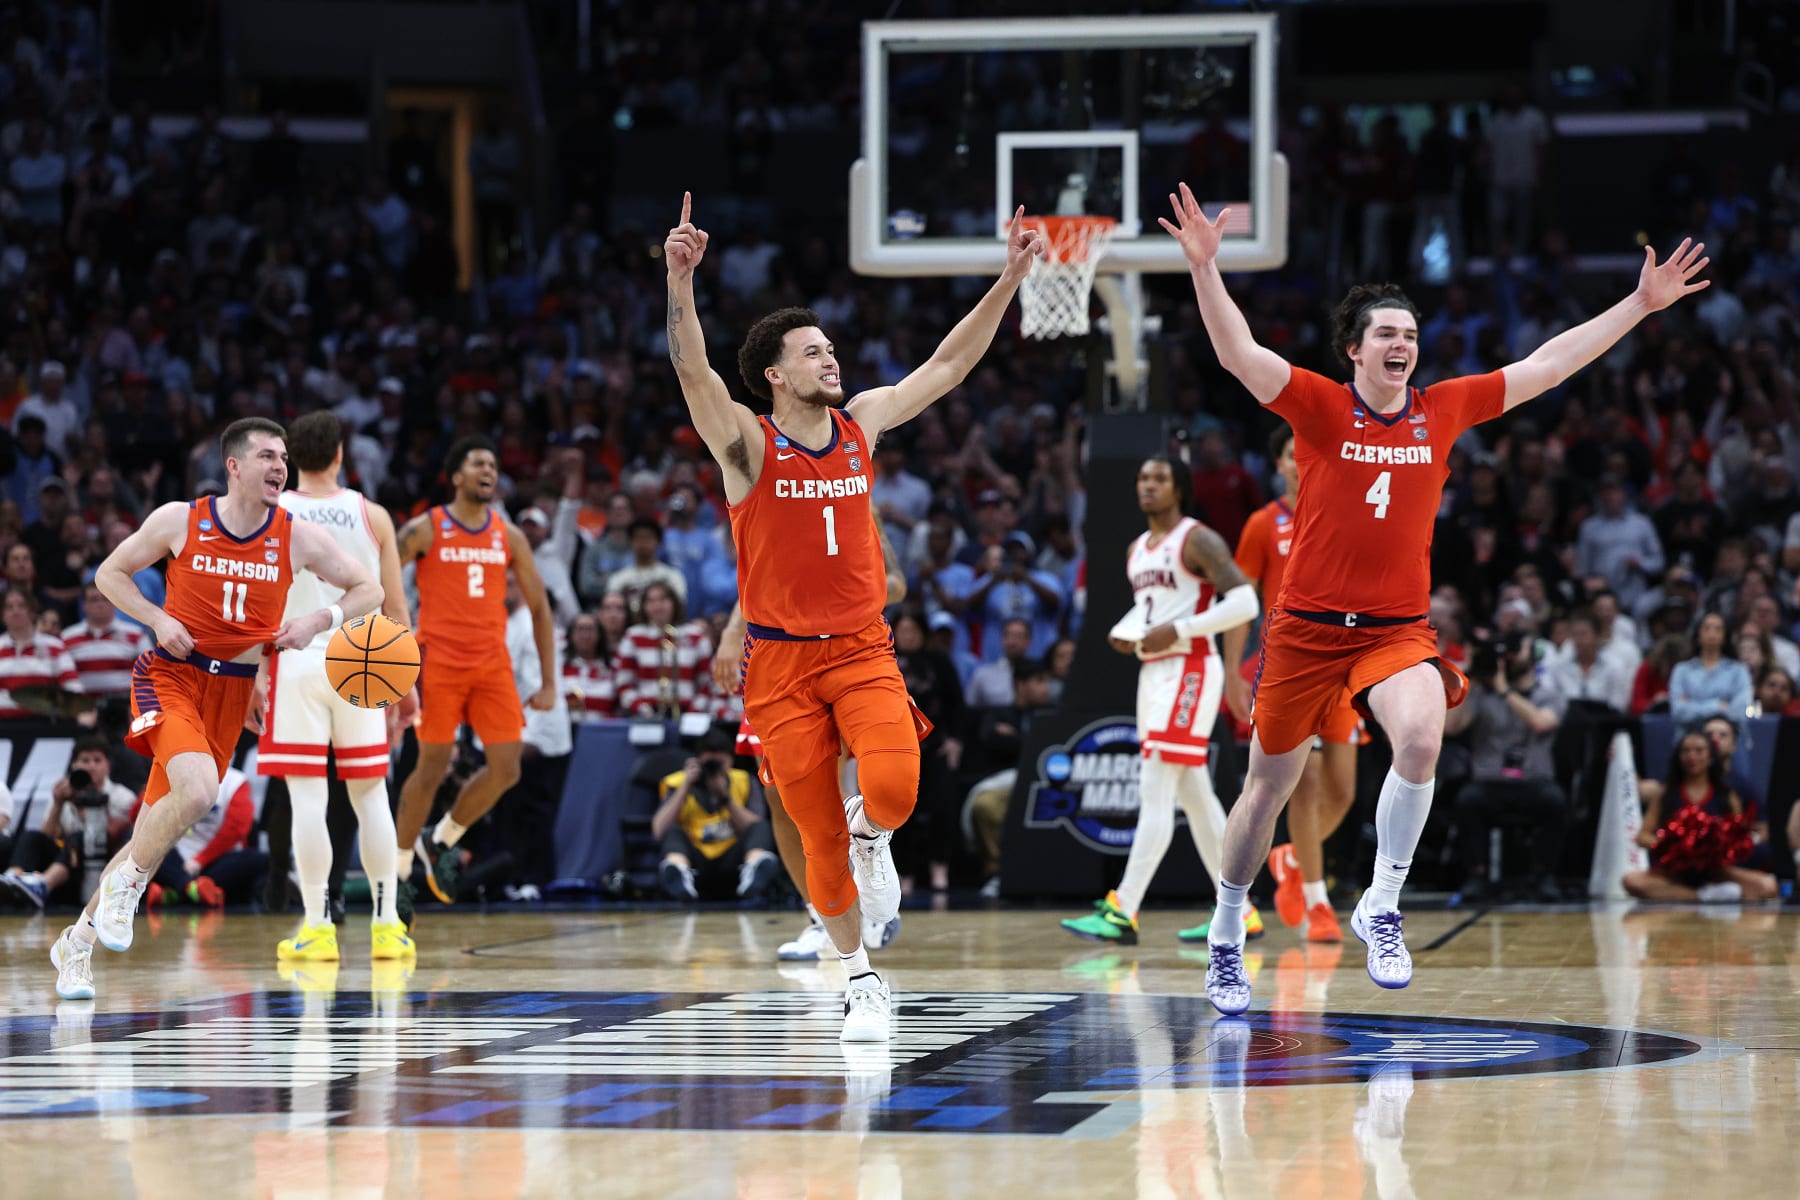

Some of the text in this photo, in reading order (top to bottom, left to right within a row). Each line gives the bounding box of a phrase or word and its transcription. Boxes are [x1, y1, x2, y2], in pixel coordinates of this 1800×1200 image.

[1340, 441, 1433, 464] CLEMSON
[775, 474, 868, 498] CLEMSON
[1365, 471, 1392, 519] 4
[300, 507, 358, 529] RSSON
[822, 505, 839, 556] 1
[192, 554, 279, 582] CLEMSON
[467, 564, 485, 598] 2
[222, 581, 248, 622] 11
[1345, 612, 1357, 627] C
[209, 659, 221, 674] C
